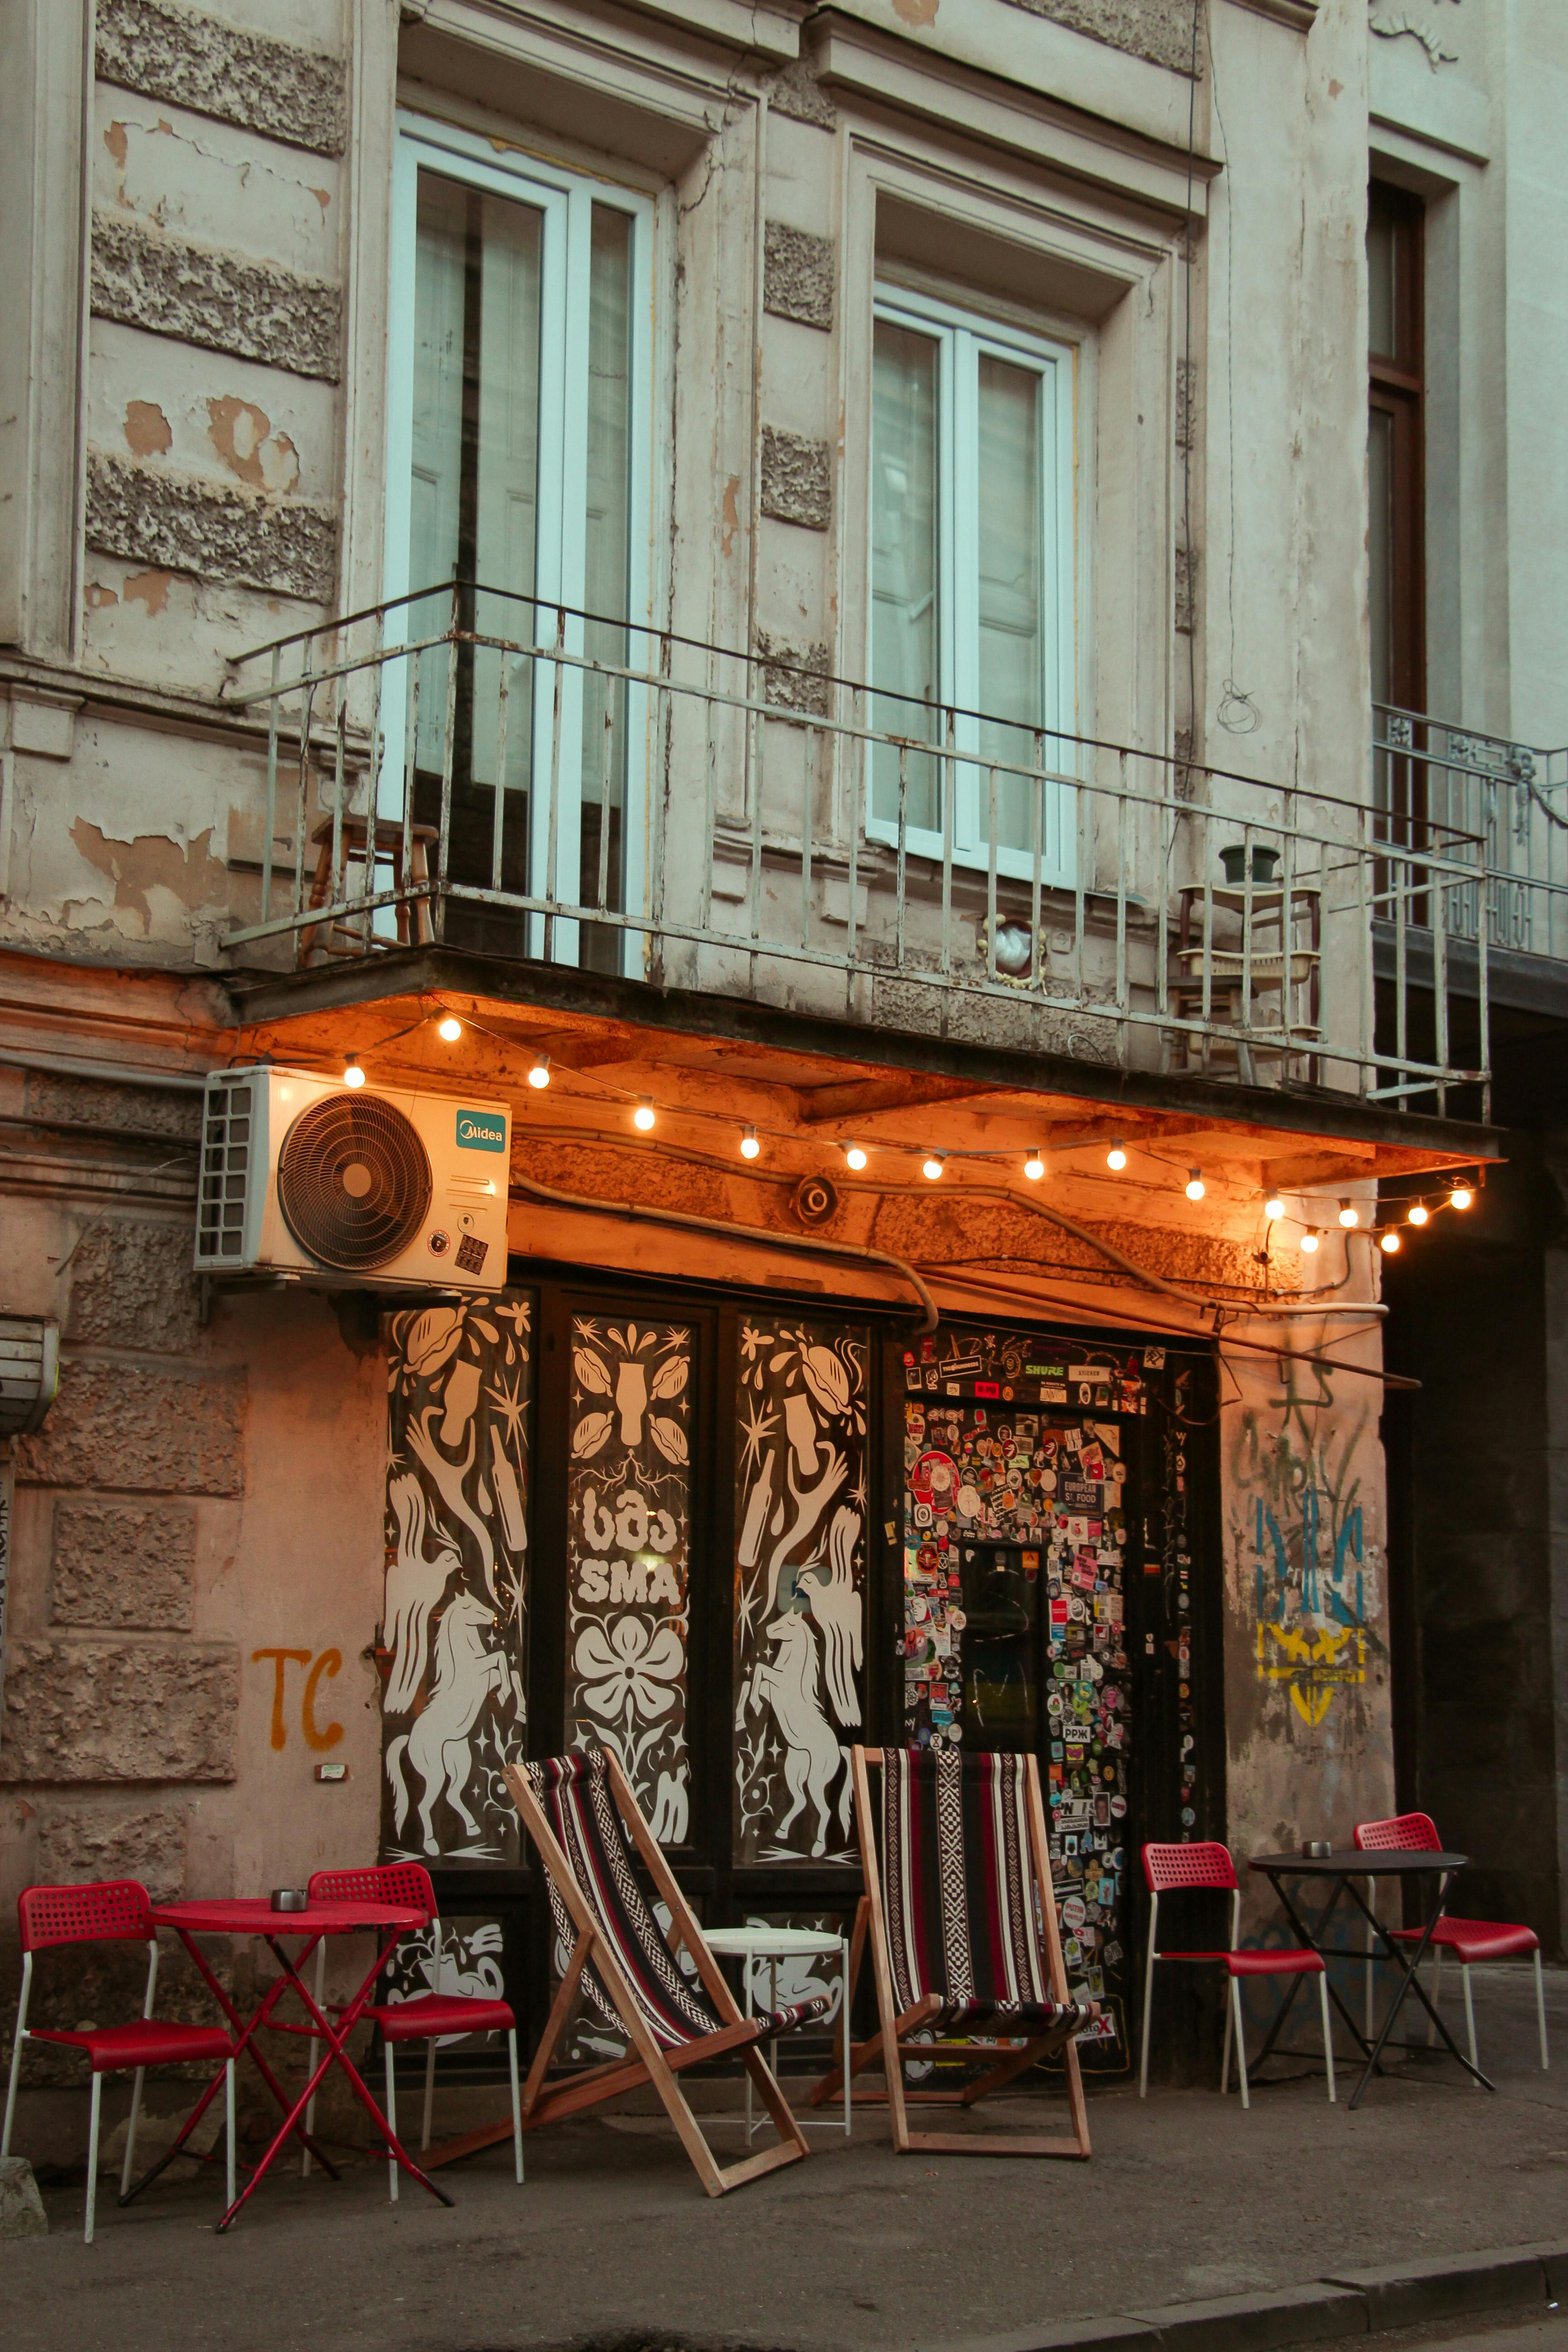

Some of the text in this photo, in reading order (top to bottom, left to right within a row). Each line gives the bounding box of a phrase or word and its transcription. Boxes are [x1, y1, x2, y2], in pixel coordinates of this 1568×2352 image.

[460, 1120, 502, 1142] Midea
[1025, 1365, 1063, 1376] SHURE
[1065, 1481, 1096, 1493] EUROPEAN
[1077, 1494, 1096, 1503] FOOD
[578, 1558, 681, 1605] SMA
[251, 1648, 344, 1752] TC
